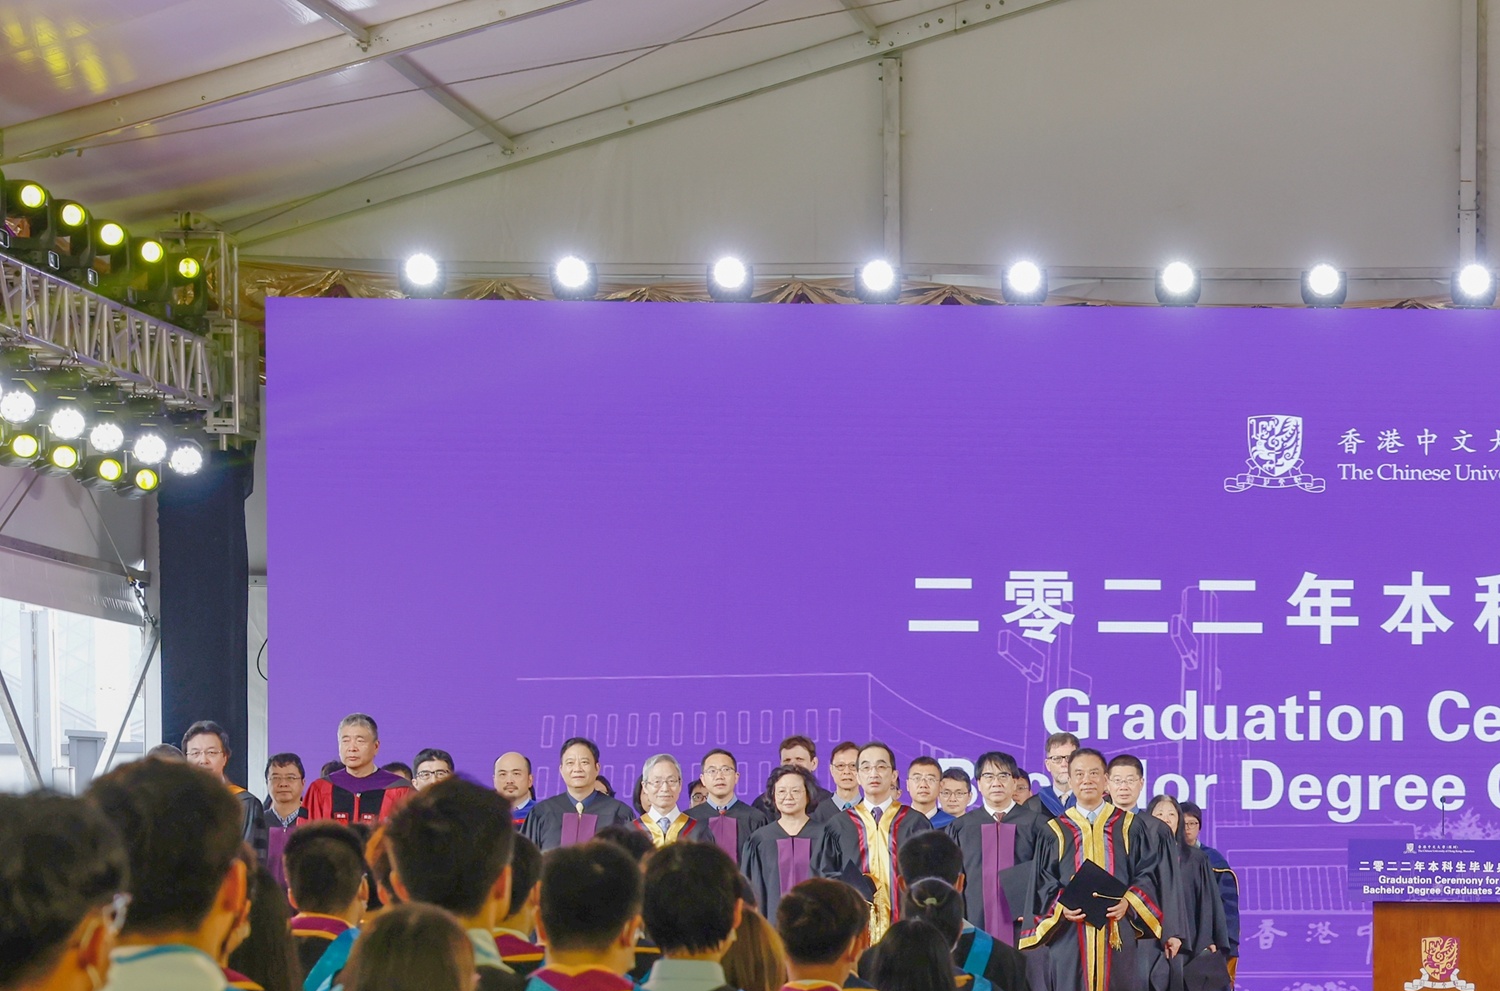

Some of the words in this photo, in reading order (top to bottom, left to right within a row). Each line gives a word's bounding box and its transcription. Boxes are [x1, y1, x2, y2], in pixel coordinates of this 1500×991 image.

[1337, 463, 1374, 481] The
[1377, 463, 1451, 481] Chinese
[1043, 688, 1403, 741] Graduation
[1241, 759, 1466, 823] Degree
[1378, 875, 1432, 885] Graduation
[1434, 875, 1484, 886] Ceremony
[1486, 875, 1500, 885] for
[1363, 886, 1405, 895] Bachelor
[1407, 886, 1441, 897] Degree
[1443, 887, 1493, 896] Graduates
